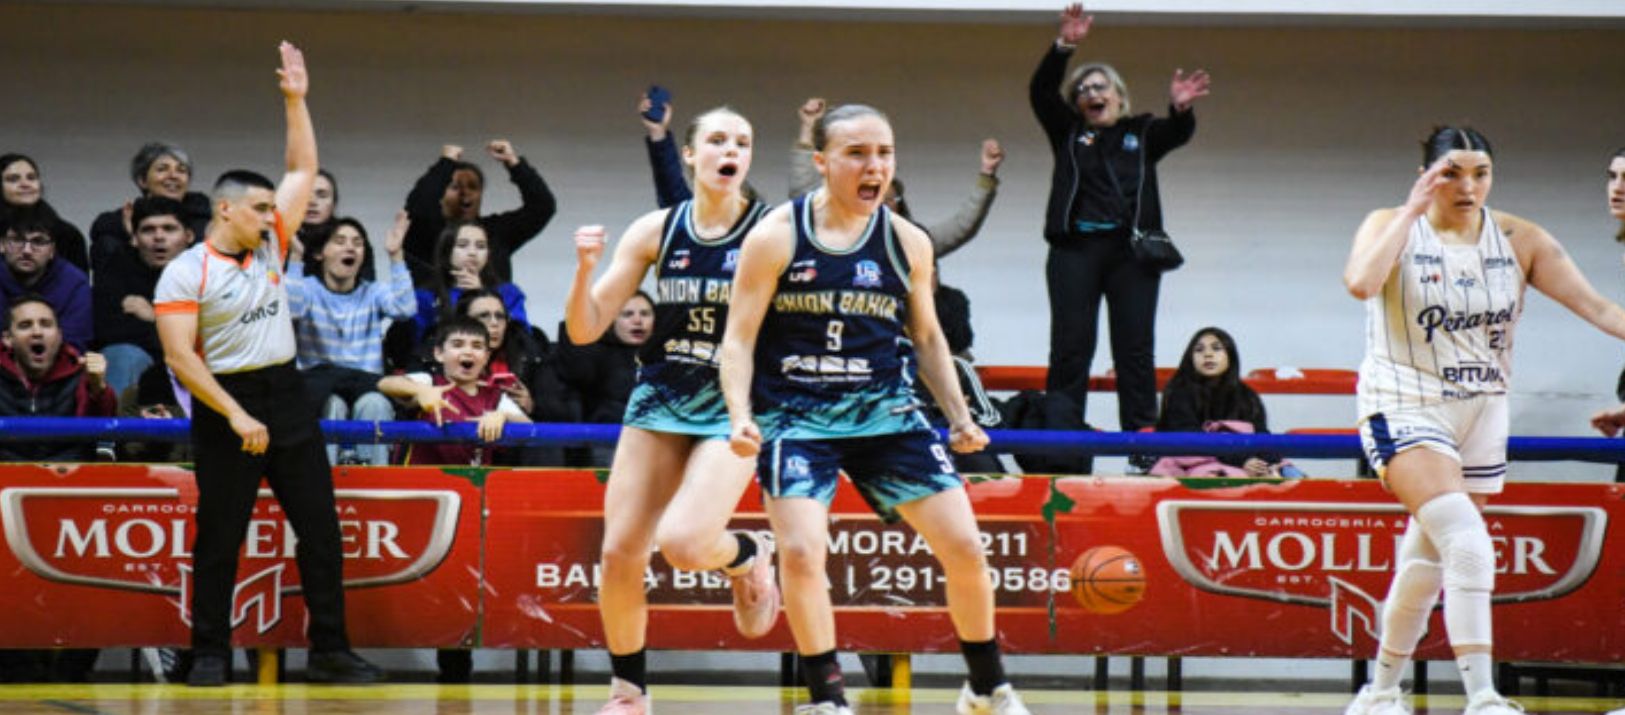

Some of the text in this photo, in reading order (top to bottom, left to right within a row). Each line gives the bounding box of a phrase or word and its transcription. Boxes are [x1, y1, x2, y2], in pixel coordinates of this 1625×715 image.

[658, 279, 700, 303] NION
[687, 306, 716, 334] 55
[1417, 300, 1515, 343] Peñarol
[827, 320, 844, 351] 9
[930, 444, 955, 473] 9
[1254, 516, 1386, 528] CARROCERÍA
